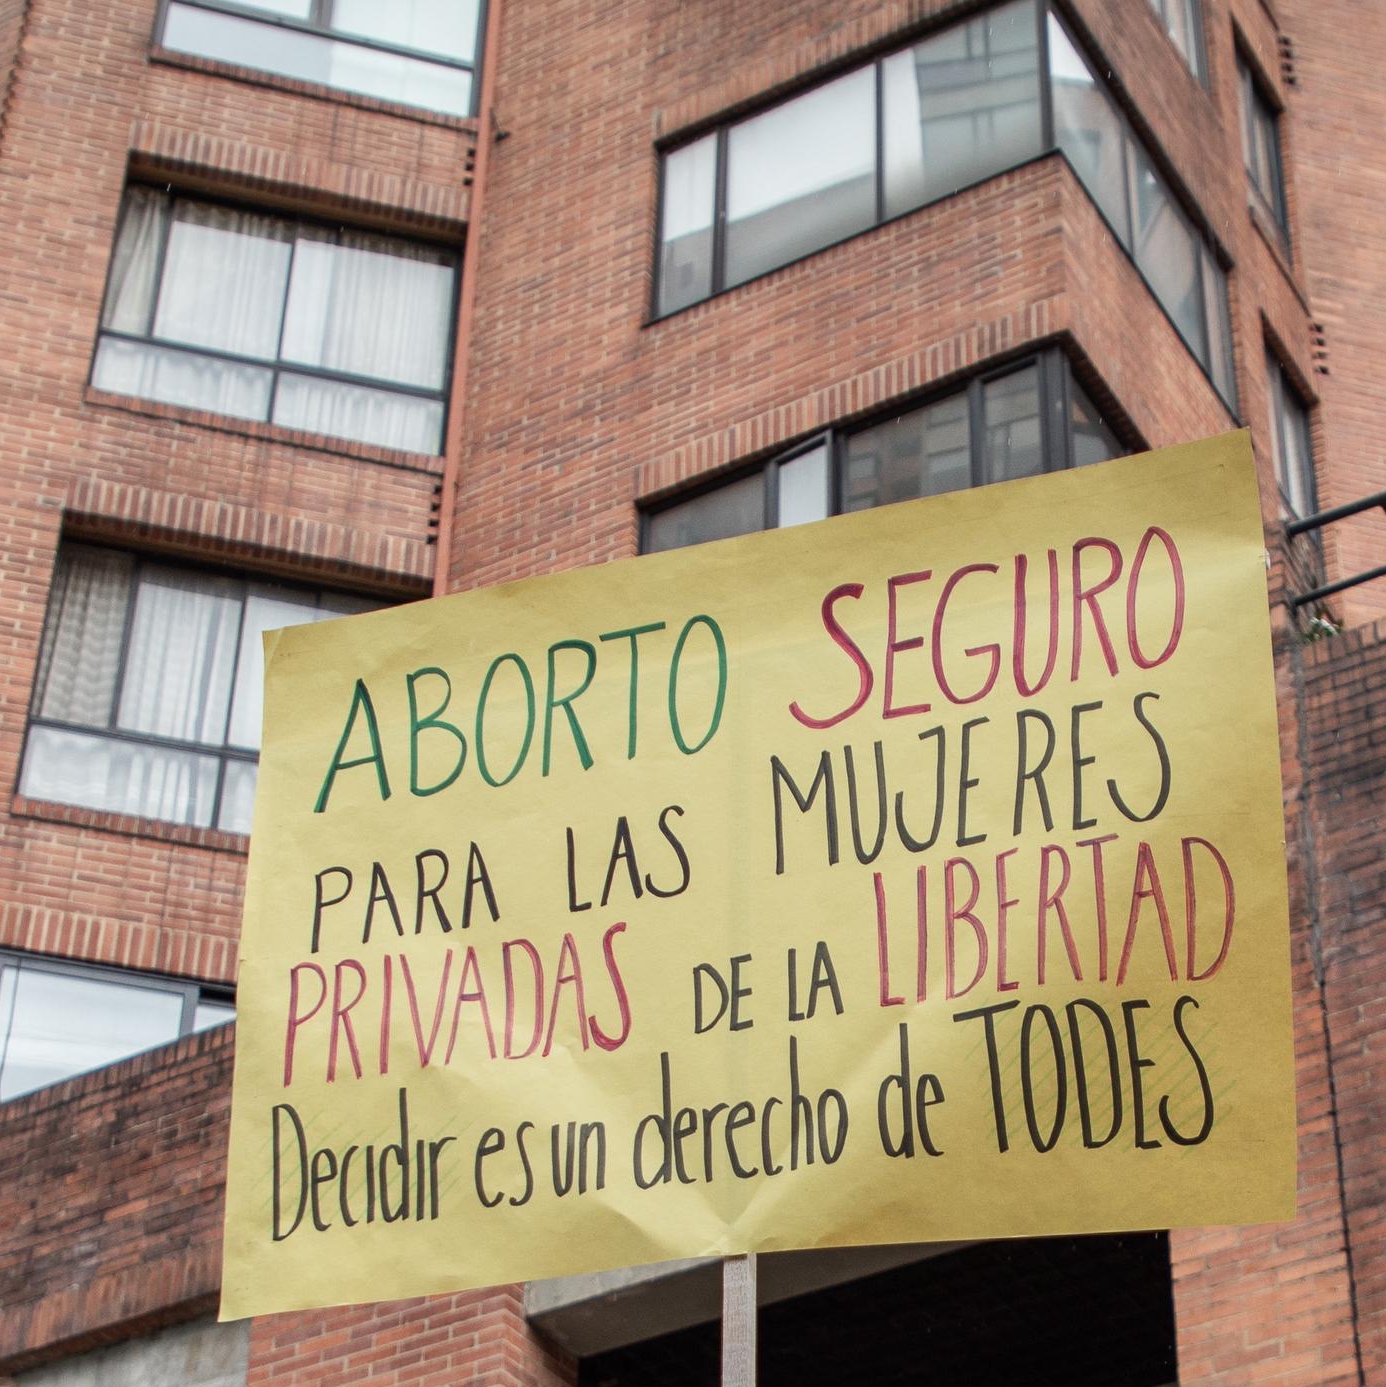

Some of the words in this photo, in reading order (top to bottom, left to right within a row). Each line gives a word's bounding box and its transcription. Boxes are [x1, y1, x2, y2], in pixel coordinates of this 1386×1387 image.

[313, 613, 728, 814] ABORTO
[788, 525, 1186, 730] SEGURO
[310, 841, 500, 954] PARA
[566, 804, 692, 913] LAS
[771, 691, 1173, 875] MUJERES
[282, 921, 633, 1087] PRIVADAS
[693, 954, 753, 1035] DE
[787, 941, 844, 1024] LA
[872, 835, 1235, 1008] LIBERTAD
[269, 1087, 451, 1242] Decidir
[474, 1125, 534, 1209] es
[552, 1121, 606, 1193] un
[632, 1036, 849, 1190] derecho
[877, 1024, 945, 1161] de
[954, 995, 1213, 1153] TODES
